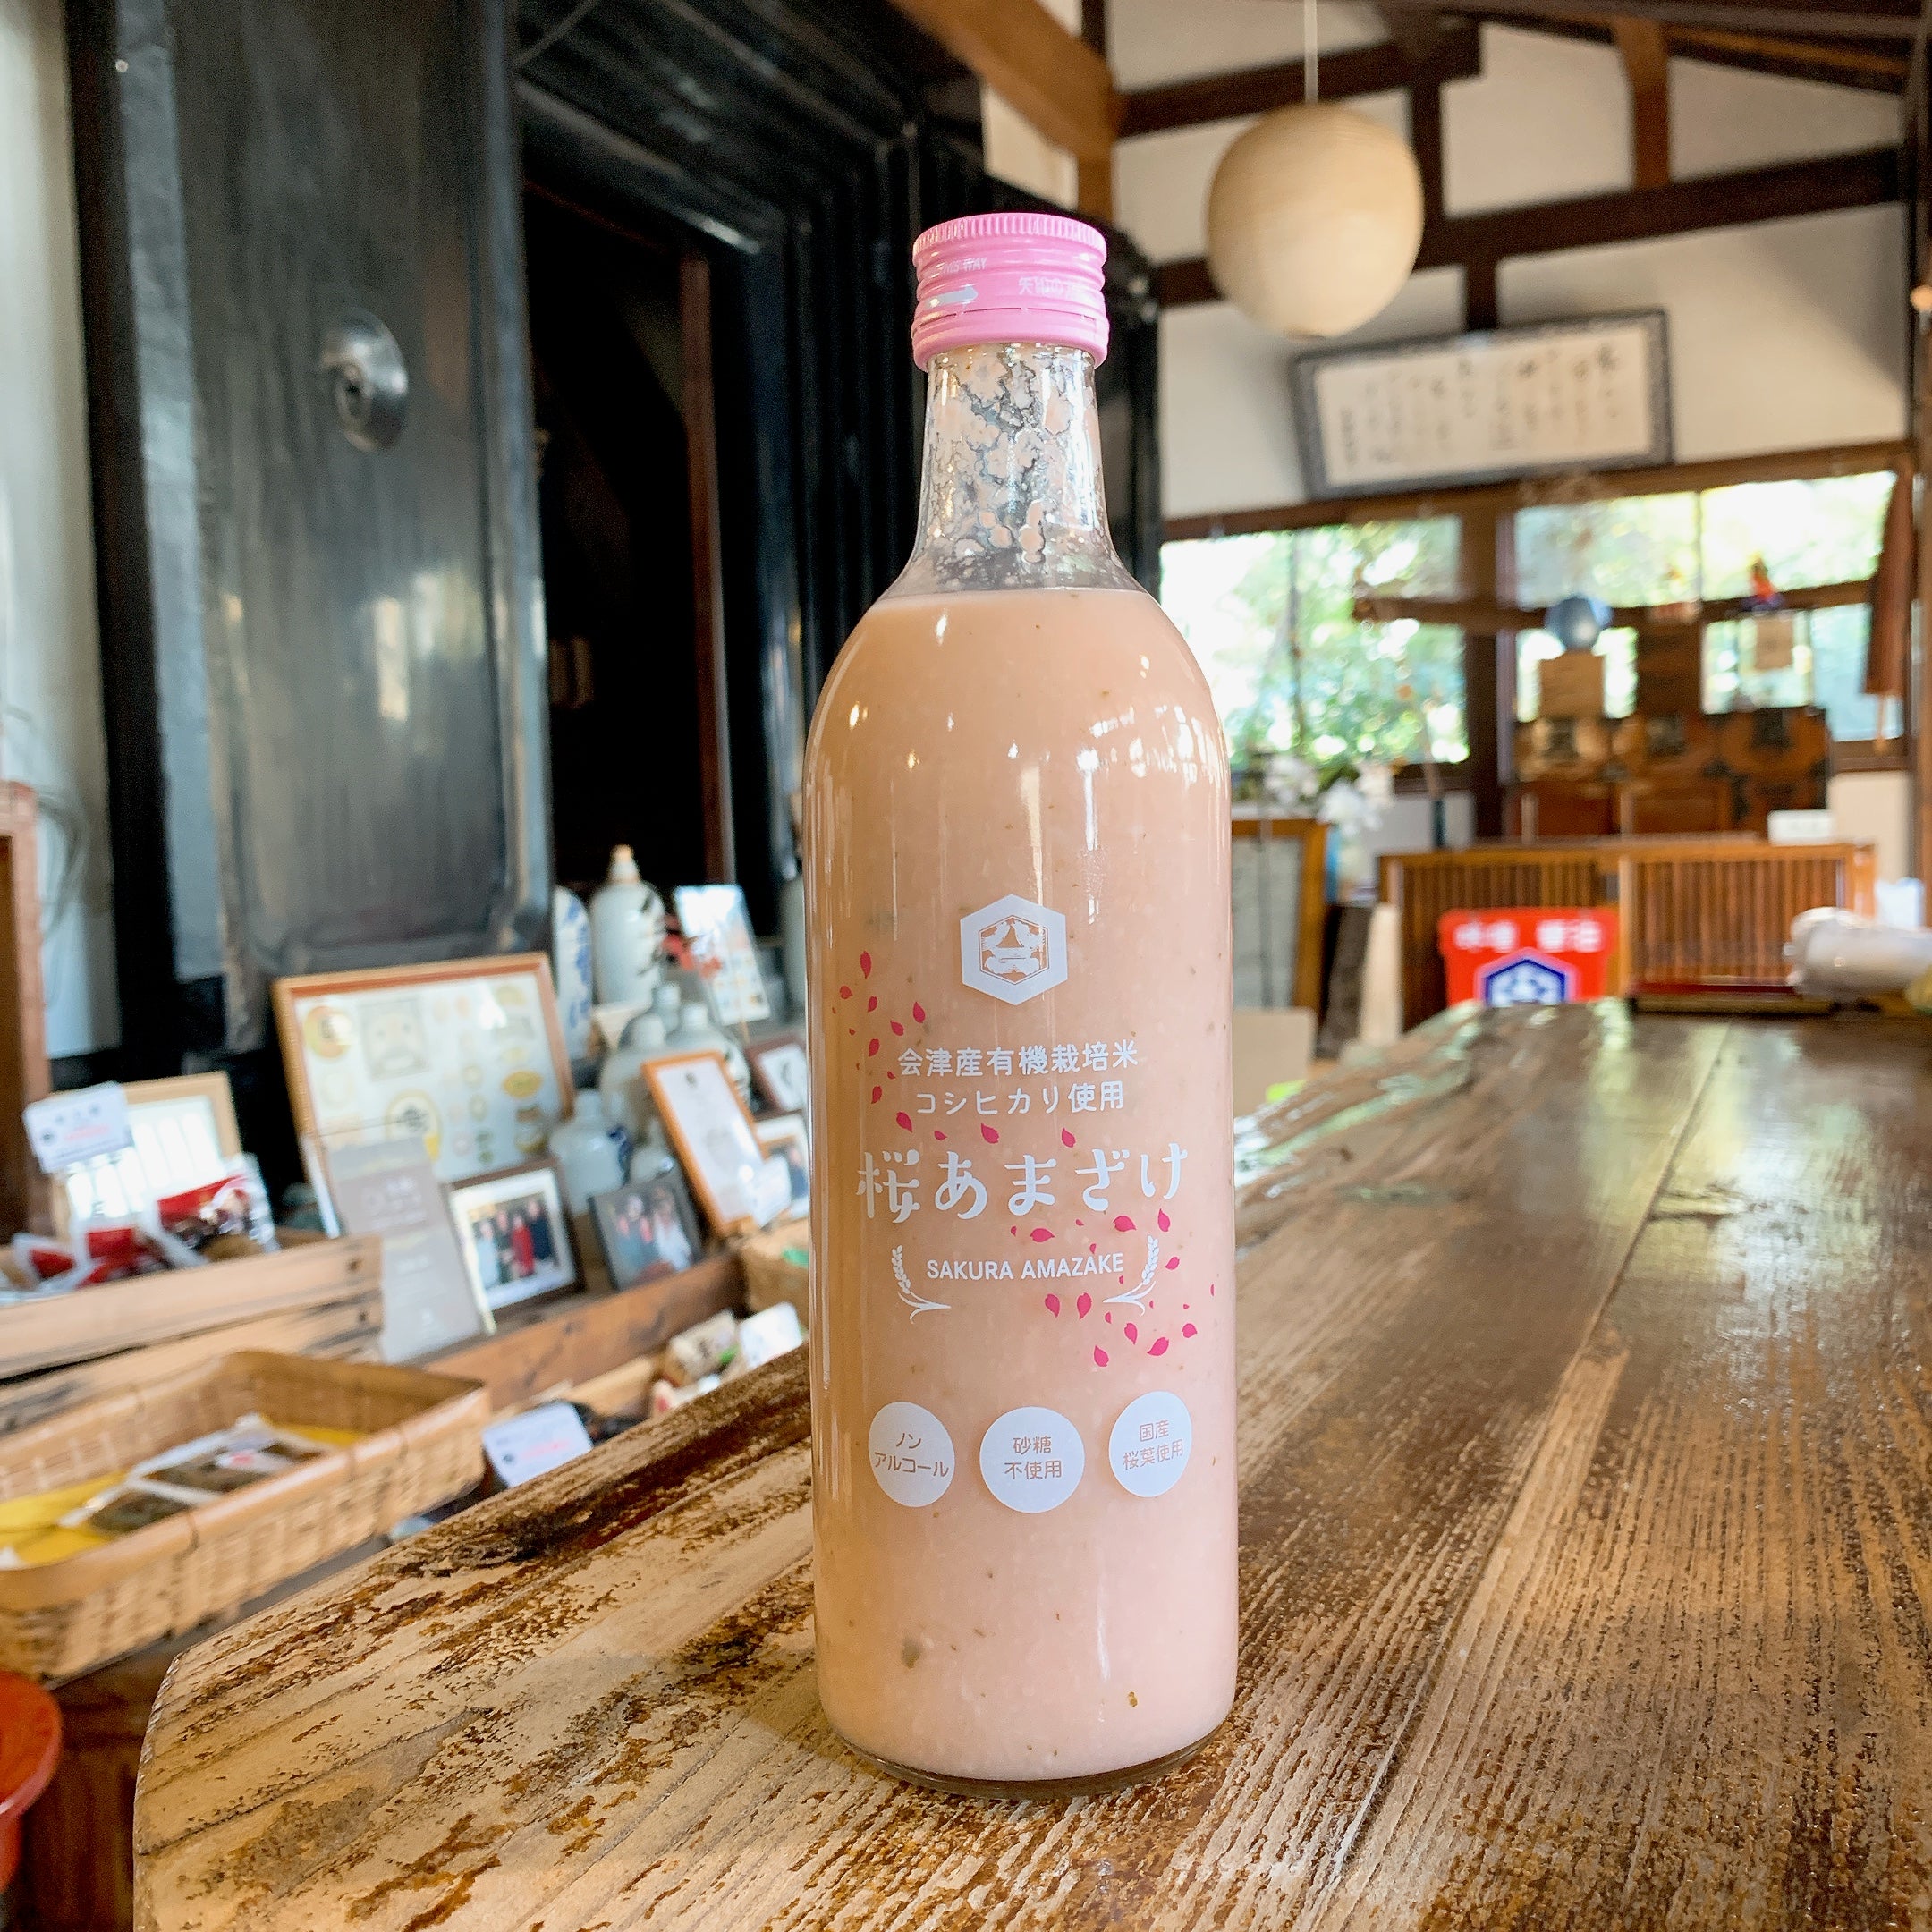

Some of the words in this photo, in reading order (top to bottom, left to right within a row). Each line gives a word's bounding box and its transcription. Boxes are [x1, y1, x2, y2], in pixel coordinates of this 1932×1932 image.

[898, 1038, 1139, 1077] 会津産有機栽培米
[917, 1080, 1124, 1115] コシヒカリ使用
[856, 1142, 1188, 1224] 桜あまざけ
[927, 1259, 1013, 1280] SAKURA
[1021, 1253, 1124, 1280] AMAZAKE
[895, 1432, 922, 1450] ノン
[1138, 1419, 1170, 1443] 国産
[1013, 1436, 1053, 1454] 砂糖
[1122, 1439, 1184, 1470] 桜葉使用
[873, 1451, 950, 1478] アルコール
[1004, 1460, 1063, 1480] 不使用
